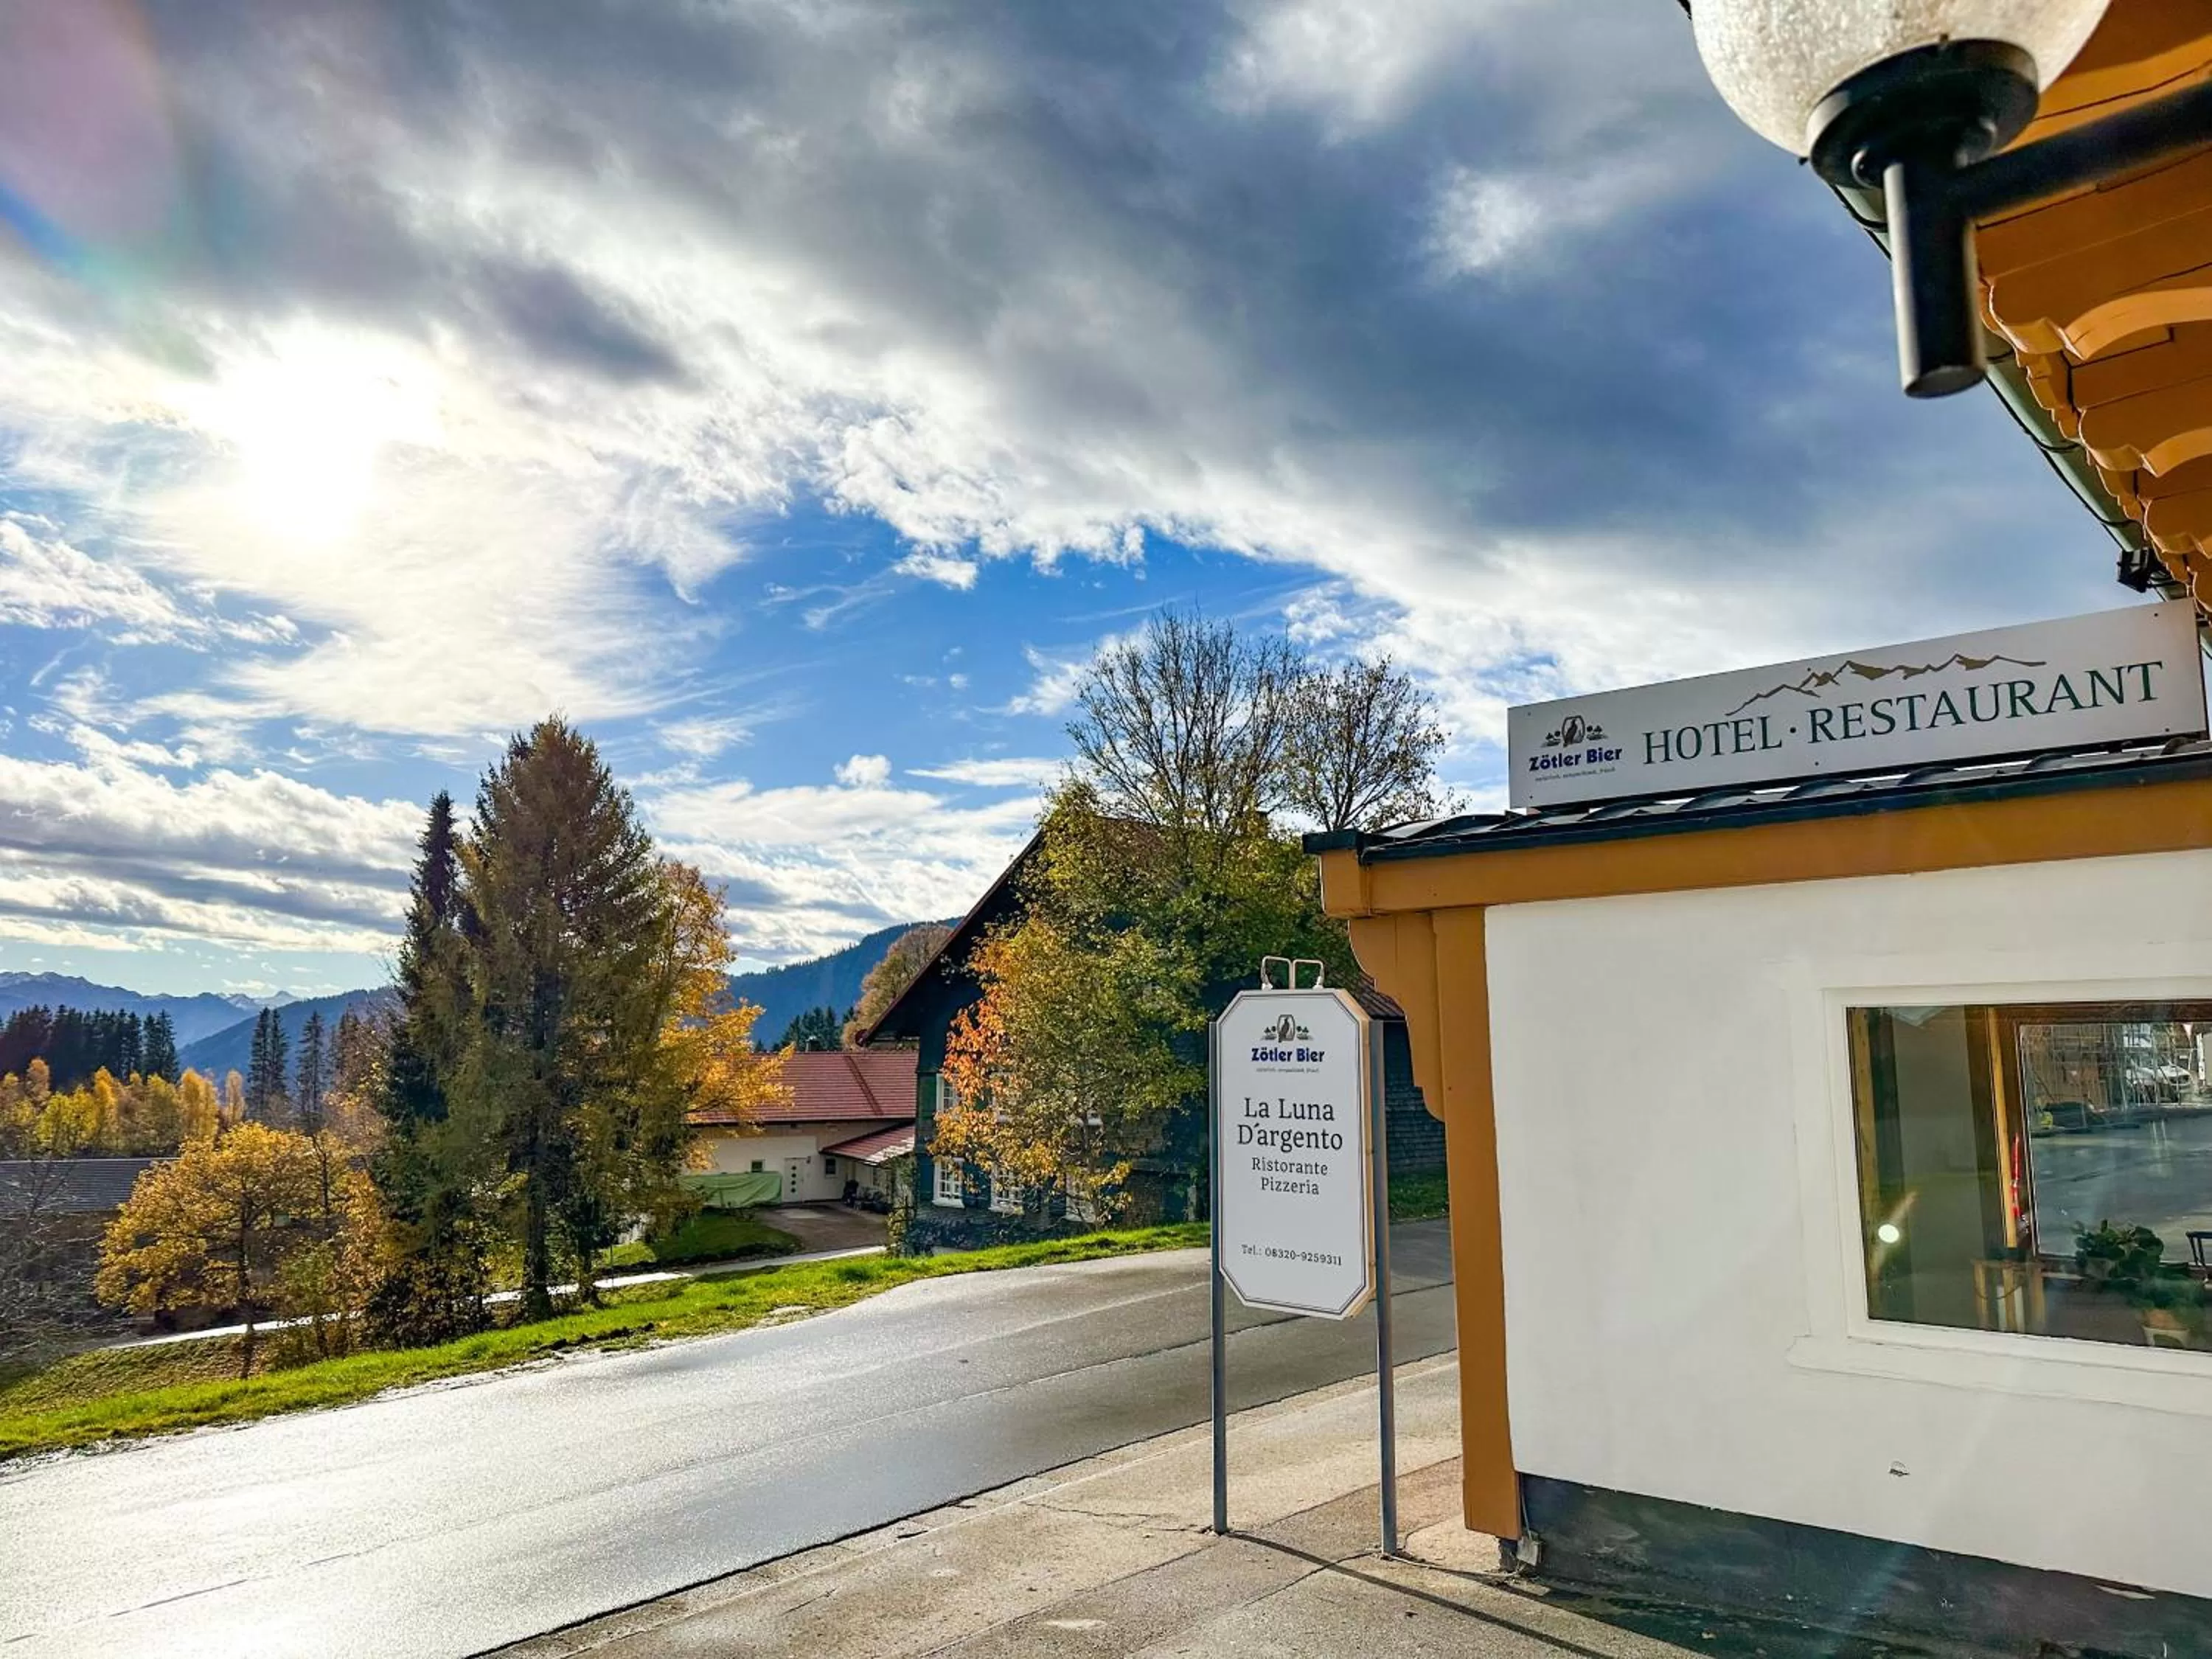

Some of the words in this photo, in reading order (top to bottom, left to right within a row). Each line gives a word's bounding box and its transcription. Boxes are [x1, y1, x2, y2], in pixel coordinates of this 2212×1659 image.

[1643, 714, 1782, 764] HOTEL
[1807, 661, 2162, 743] RESTAURANT
[1528, 753, 1582, 771] Zötler
[1586, 747, 1622, 764] Bier
[1251, 1047, 1293, 1062] Zötler
[1296, 1047, 1325, 1062] Bier
[1244, 1097, 1270, 1119] La
[1278, 1099, 1335, 1121] Luna
[1252, 1156, 1328, 1175] Ristorante
[1261, 1177, 1319, 1194] Pizzeria
[1265, 1247, 1342, 1266] 08320-9259311
